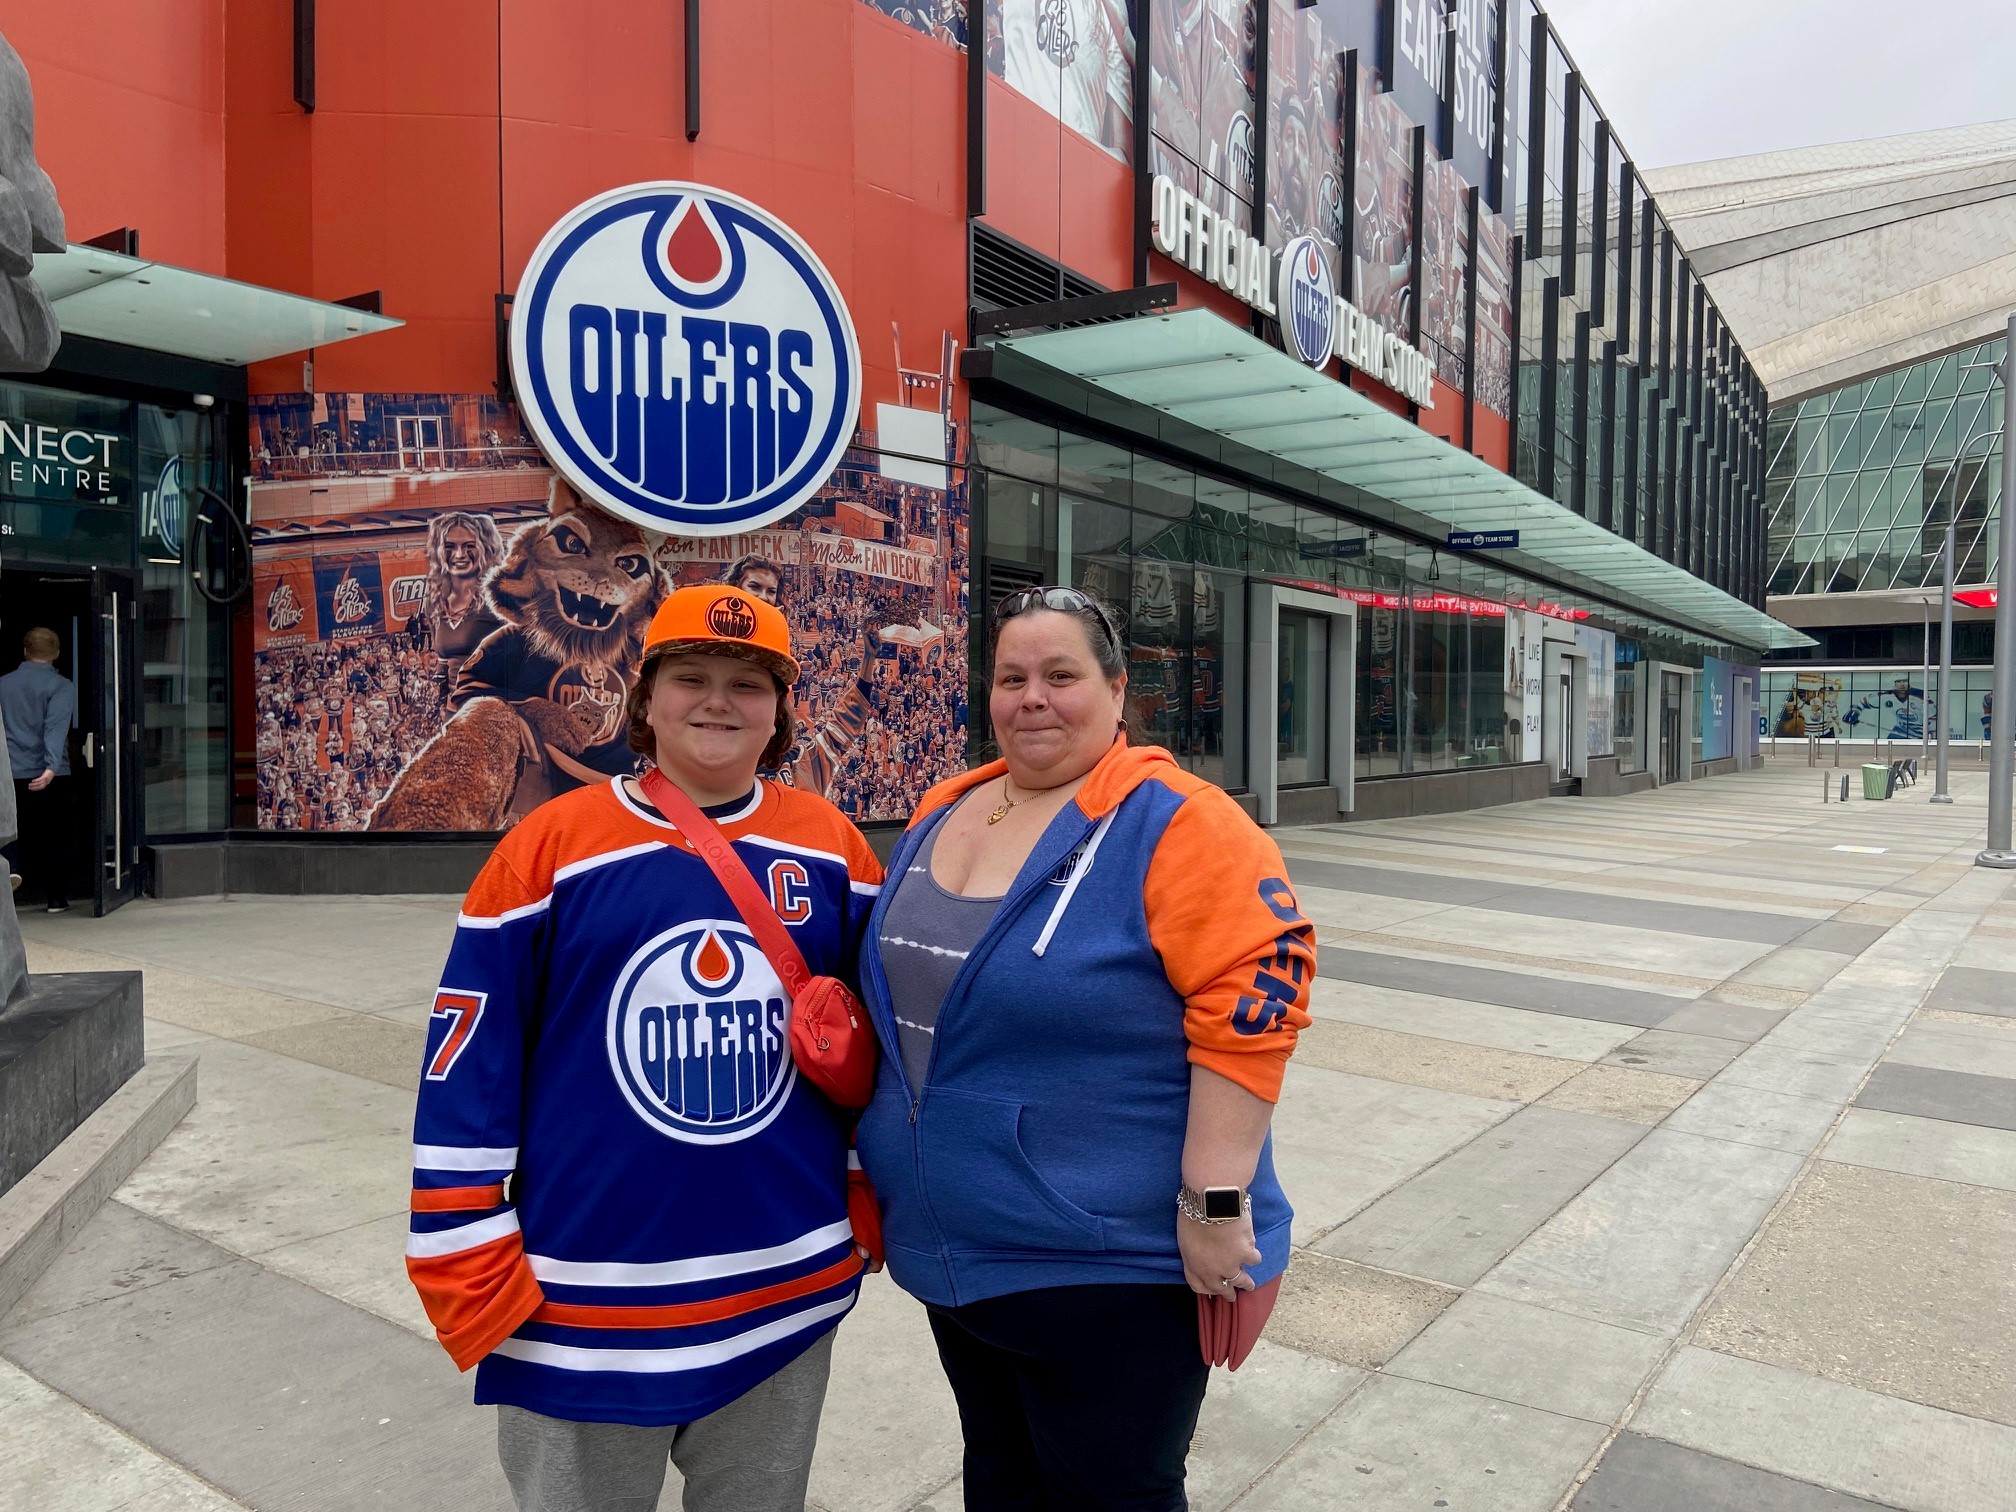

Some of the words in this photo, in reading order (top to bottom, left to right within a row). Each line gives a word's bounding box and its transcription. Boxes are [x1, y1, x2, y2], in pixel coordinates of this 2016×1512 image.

[1037, 14, 1079, 67] OILERS
[1400, 0, 1446, 103] EAM
[1152, 174, 1277, 316] OFFICIAL
[1335, 295, 1383, 380] TEAM
[1383, 332, 1435, 410] STORE
[0, 420, 119, 468] NECT
[0, 461, 110, 492] ENTRE
[698, 536, 732, 559] FAN
[738, 533, 784, 561] DECK
[813, 542, 863, 566] Molson
[865, 547, 887, 575] FAN
[891, 552, 921, 583] DECK
[268, 585, 293, 608] LET'S
[335, 578, 360, 601] LET'S
[342, 592, 360, 606] GO
[269, 608, 305, 632] OILERS
[335, 600, 372, 624] OILERS
[332, 629, 373, 639] PLAYOFFS
[1528, 643, 1540, 661] LIVE
[1526, 678, 1541, 696] WORK
[1526, 715, 1539, 732] PLAY
[767, 858, 812, 925] C
[426, 987, 488, 1081] 7
